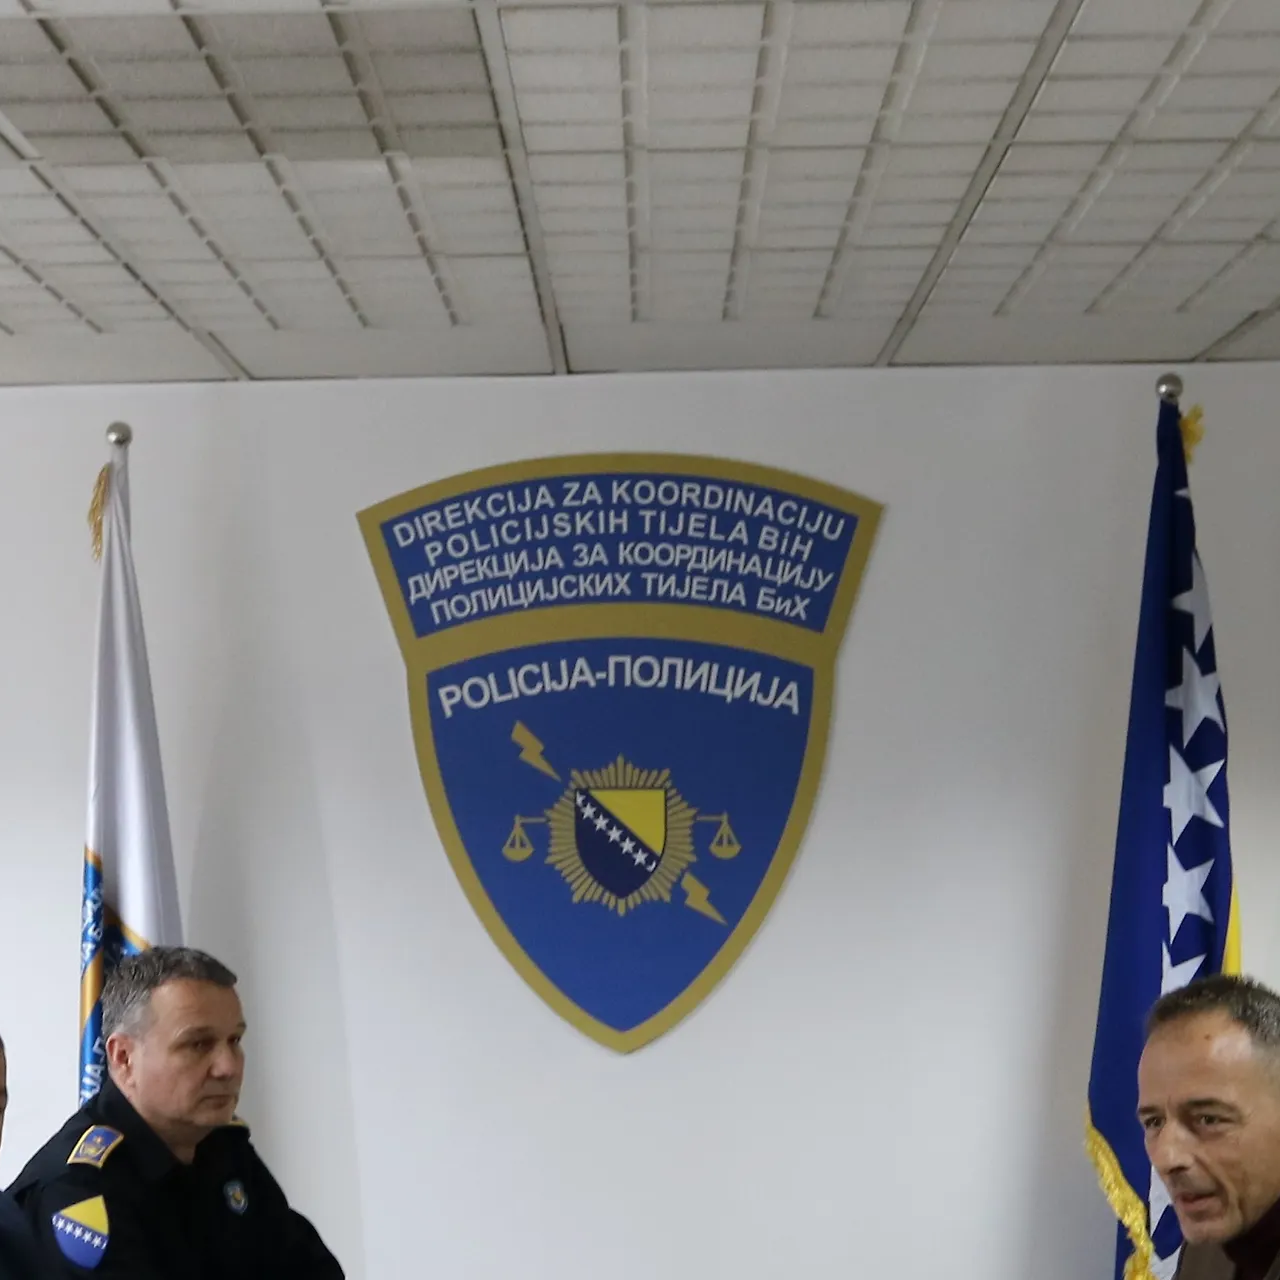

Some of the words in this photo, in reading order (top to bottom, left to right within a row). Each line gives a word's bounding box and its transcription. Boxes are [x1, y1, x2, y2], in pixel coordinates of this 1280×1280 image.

[392, 484, 556, 548] DIREKCIJA
[562, 480, 603, 507] ZA
[611, 479, 846, 541] KOORDINACIJU
[424, 509, 629, 567] POLICIJSKIH
[639, 510, 749, 546] TIJELA
[407, 545, 564, 606] ДИРЕКЦИЈА
[572, 542, 609, 567] ЗА
[618, 541, 835, 592] КООРДИНАЦИЈУ
[430, 572, 632, 625] ПОЛИЦИЈСКИХ
[641, 572, 747, 607] ТИЈЕЛА
[756, 586, 811, 621] БиХ
